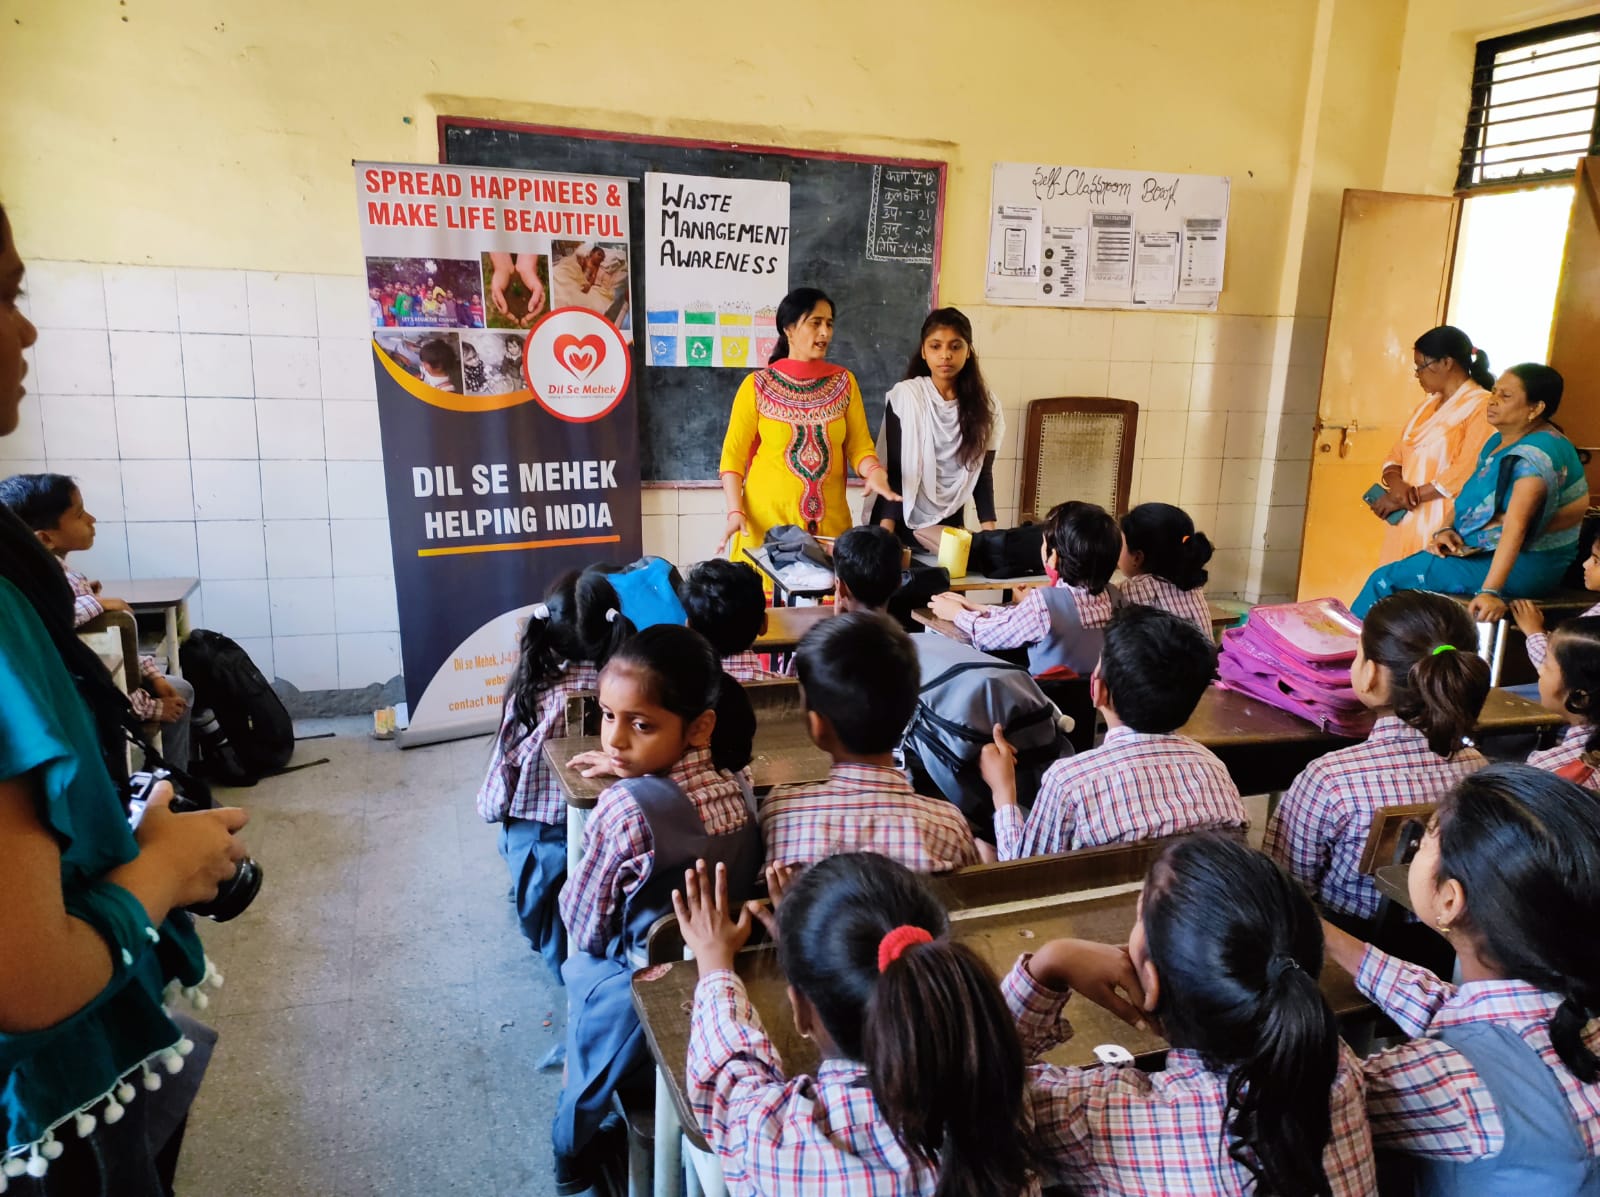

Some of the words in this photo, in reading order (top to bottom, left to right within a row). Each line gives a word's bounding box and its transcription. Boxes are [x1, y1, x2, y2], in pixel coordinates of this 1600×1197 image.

[365, 169, 462, 197] SPREAD
[470, 175, 598, 206] HAPPINEES
[606, 184, 622, 207] &
[662, 182, 733, 213] WASTE
[368, 202, 438, 227] MAKE
[446, 205, 496, 231] LIFE
[504, 209, 624, 237] BEAUTIFUL
[661, 209, 789, 246] MANAGEMENT
[660, 239, 778, 275] AWARENESS
[548, 384, 564, 394] Dil
[567, 384, 580, 394] Se
[582, 384, 617, 394] Mehek
[412, 465, 463, 498] DIL
[472, 463, 509, 496] SE
[518, 459, 618, 493] MEHEK
[424, 506, 538, 540] HELPING
[545, 502, 614, 531] INDIA
[448, 696, 484, 712] contact
